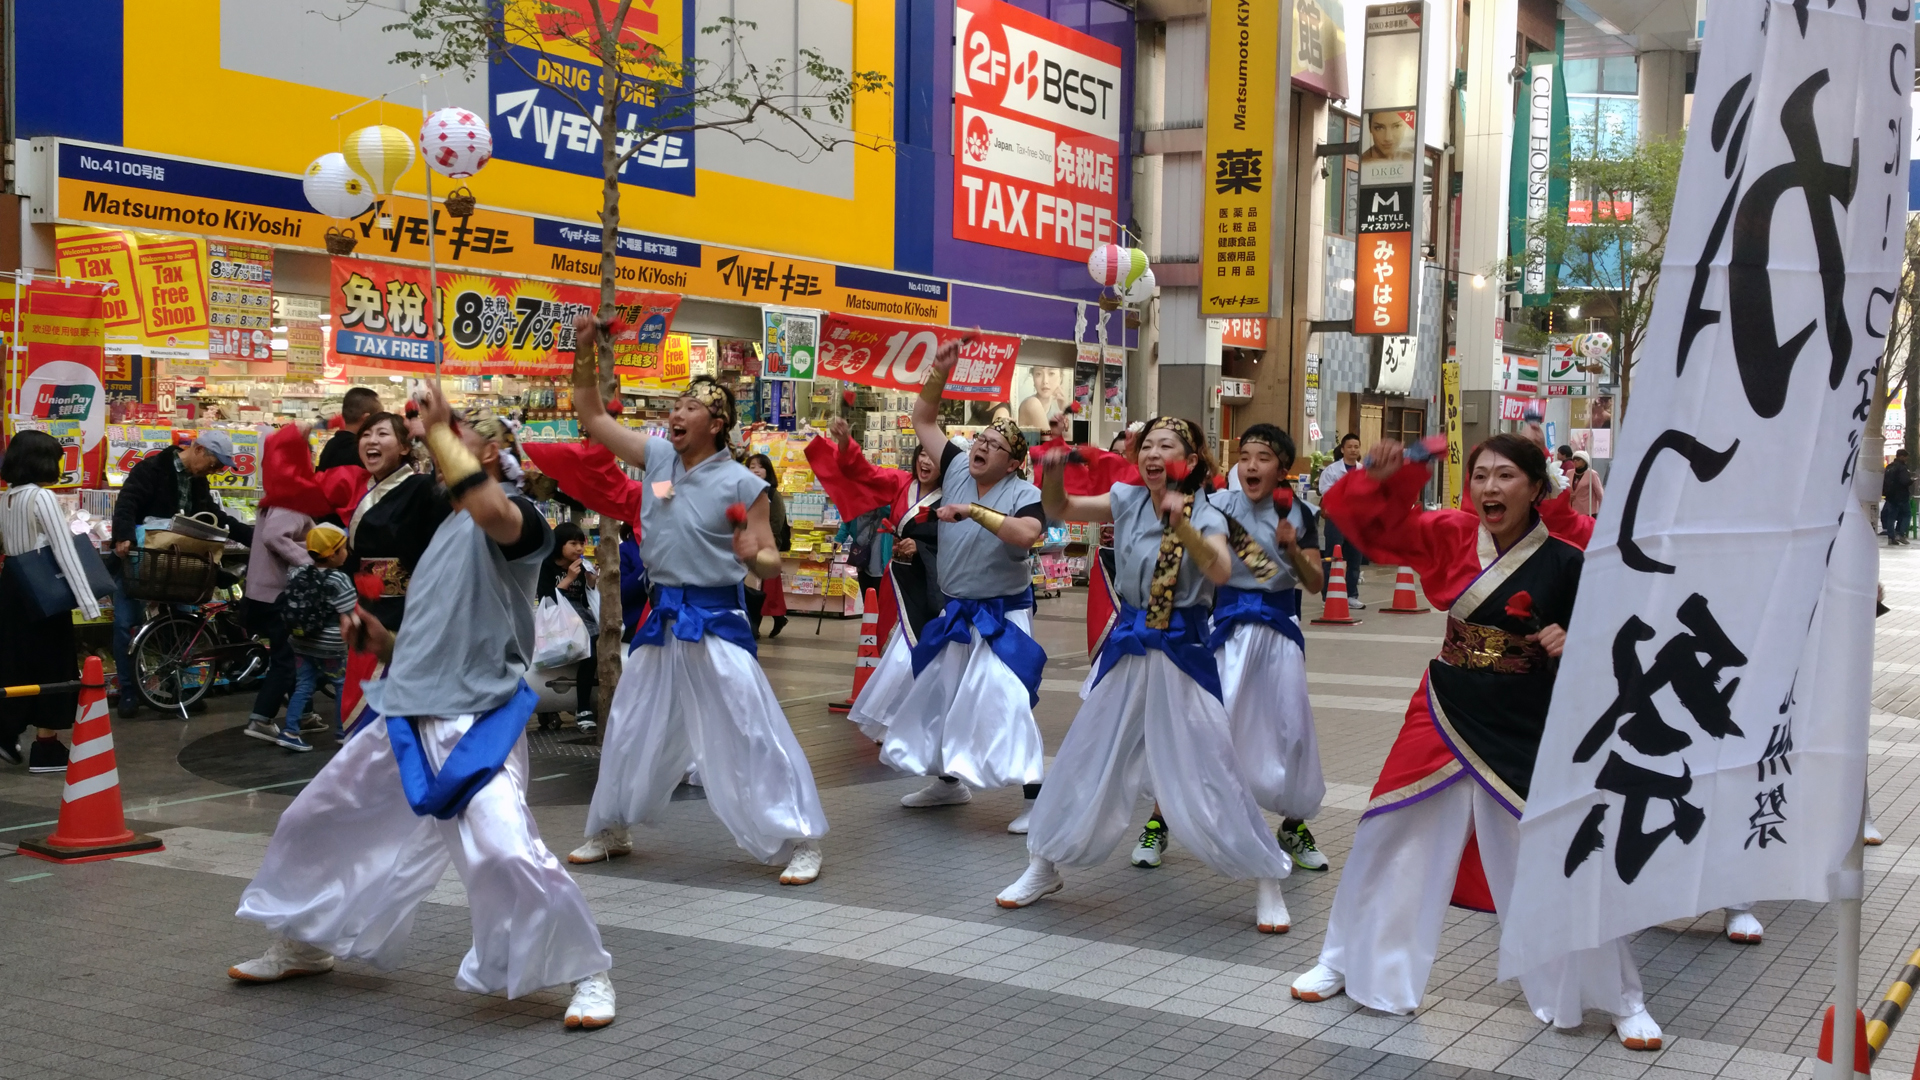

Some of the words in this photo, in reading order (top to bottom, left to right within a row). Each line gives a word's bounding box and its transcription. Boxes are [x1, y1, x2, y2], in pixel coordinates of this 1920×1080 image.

[968, 30, 1007, 86] 2F
[537, 58, 591, 92] DRUG
[597, 74, 656, 109] SORE
[1043, 59, 1114, 120] BEST
[1233, 30, 1249, 131] Matsumoto
[1531, 75, 1551, 129] CUT
[994, 137, 1014, 152] Japan.
[1016, 143, 1039, 160] Tax-free
[1039, 150, 1053, 165] Shop
[80, 155, 165, 182] No.4100号店
[1056, 140, 1114, 195] 免税店
[1215, 148, 1263, 195] 薬
[1528, 134, 1549, 209] HOUSE
[83, 190, 220, 227] Matsumoto
[223, 208, 302, 239] KiYoshi
[961, 174, 1031, 238] TAX
[1035, 192, 1112, 251] FREE
[1219, 207, 1257, 218] 医薬品
[1367, 213, 1404, 222] M-STYLE
[1218, 222, 1257, 233] 化粧品
[1361, 222, 1411, 231] ディスカウント
[1217, 236, 1257, 247] 健康食品
[76, 258, 113, 278] Tax
[1217, 251, 1256, 262] 医療用品
[152, 265, 183, 284] Tax
[551, 253, 635, 280] Matsuoto
[637, 265, 687, 288] KiYoshi
[716, 254, 822, 302] マツモトキヨシ
[1217, 266, 1256, 277] 日用品
[1373, 240, 1395, 327] みやはら
[152, 286, 189, 306] Free
[846, 294, 903, 314] Matsumoto
[904, 302, 938, 319] KiYoshi
[152, 306, 196, 328] Shop
[32, 324, 100, 337] 欢迎使用银联卡
[667, 336, 681, 349] Tax
[354, 336, 388, 355] TAX
[391, 341, 428, 360] FREE
[665, 350, 683, 363] Free
[664, 363, 686, 377] Shop
[794, 357, 808, 365] LINE
[951, 357, 1003, 385] 開催中!
[39, 393, 91, 406] UnionPay
